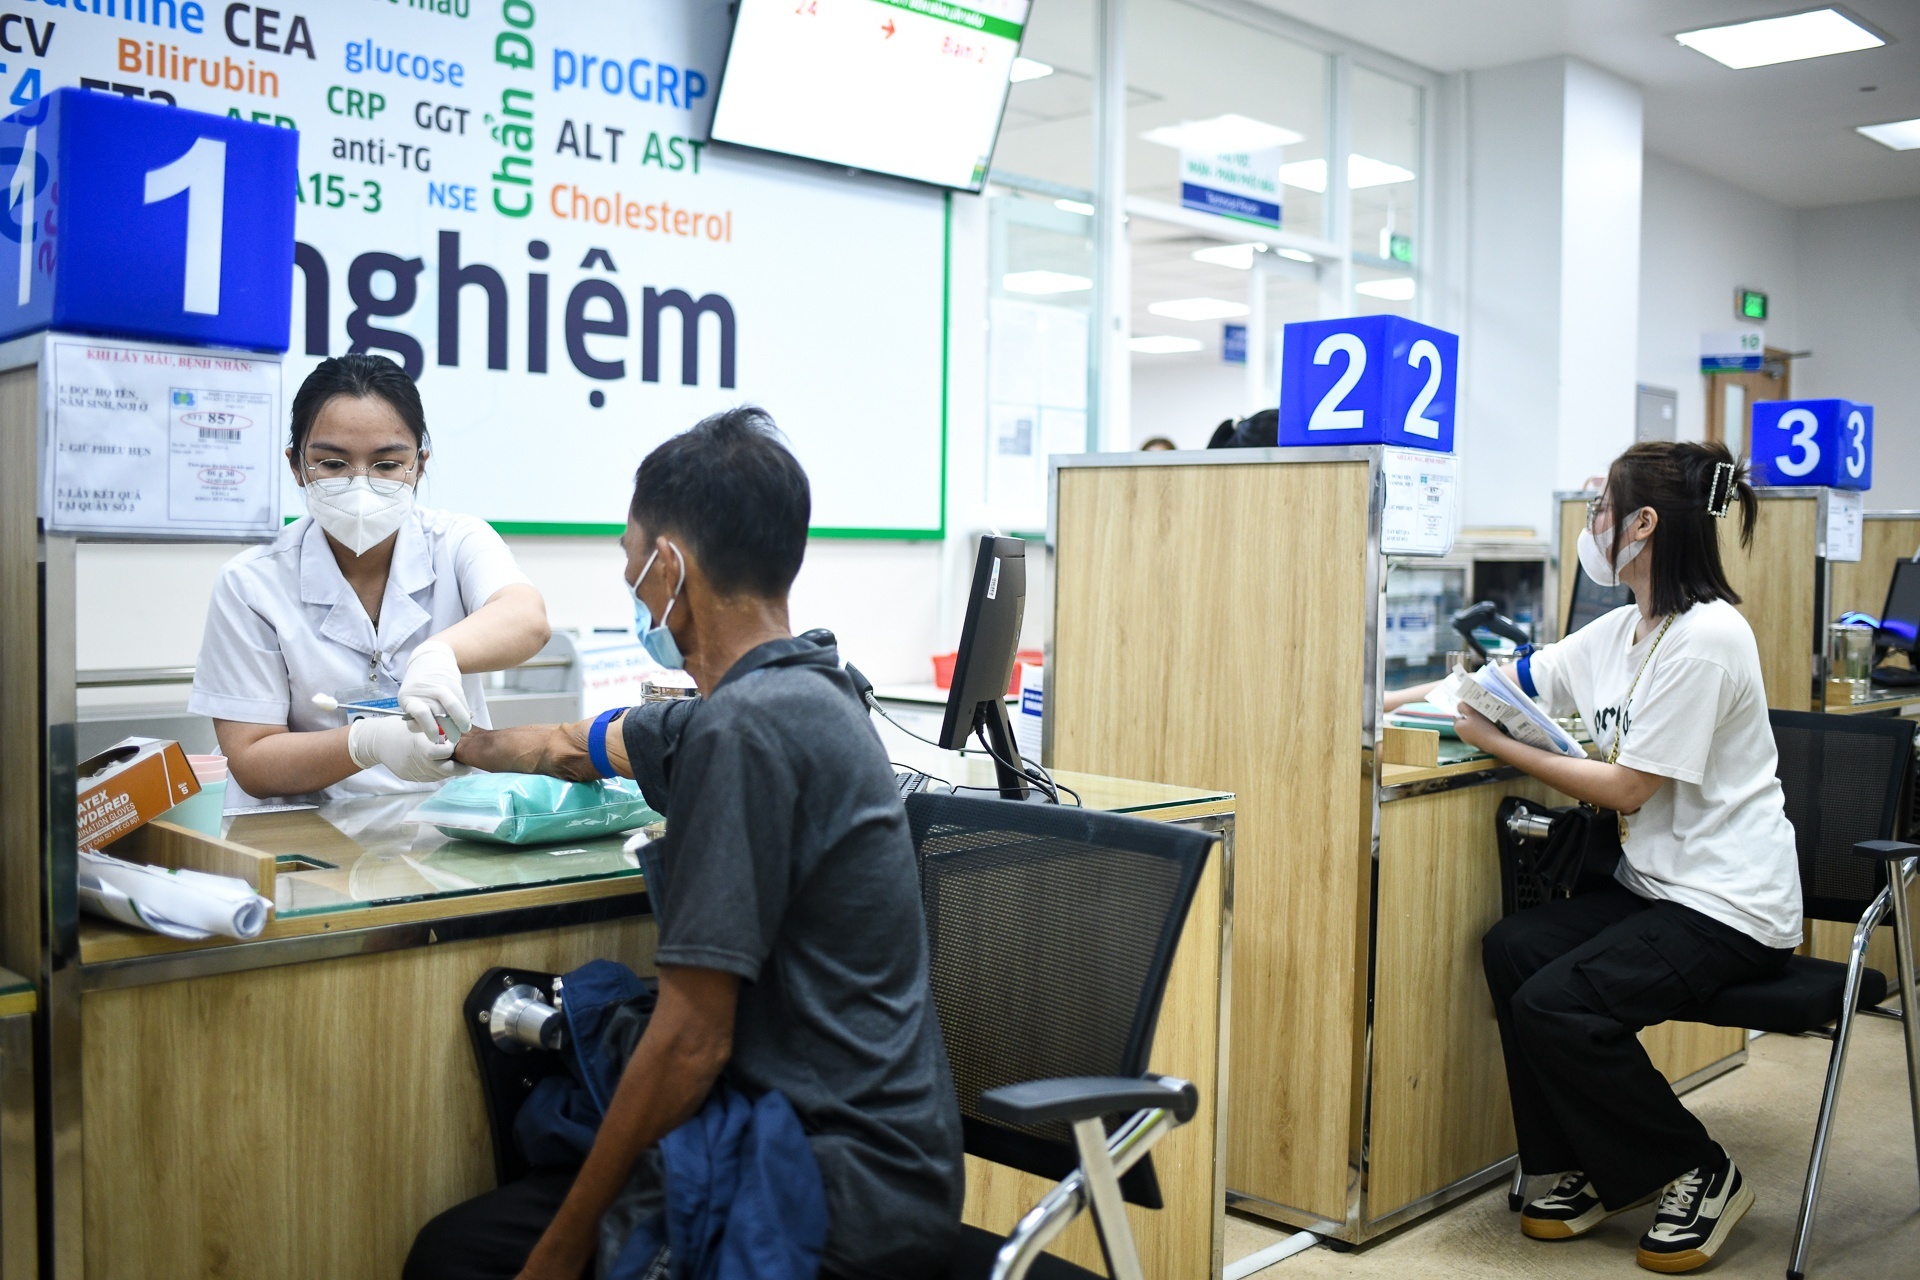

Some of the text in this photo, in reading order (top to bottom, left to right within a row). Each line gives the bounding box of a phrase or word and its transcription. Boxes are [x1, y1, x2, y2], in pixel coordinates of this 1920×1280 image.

[224, 2, 316, 60] CEA
[0, 62, 42, 108] 4
[118, 37, 279, 98] Bilirubin
[345, 38, 465, 88] glucose
[553, 47, 709, 111] proGRP
[326, 86, 386, 120] CRP
[414, 101, 470, 136] GGT
[332, 136, 431, 172] anti-TG
[555, 119, 625, 164] ALT
[642, 131, 709, 175] AST
[428, 181, 478, 213] NSE
[549, 184, 732, 243] Cholesterol
[142, 136, 227, 316] 1
[87, 349, 110, 361] KHI
[1308, 332, 1367, 431] 2
[1403, 339, 1442, 440] 2
[208, 412, 235, 425] 857
[1775, 408, 1821, 478] 3
[1845, 410, 1866, 479] 3
[77, 789, 109, 816] ATEX
[77, 793, 130, 829] WDERED
